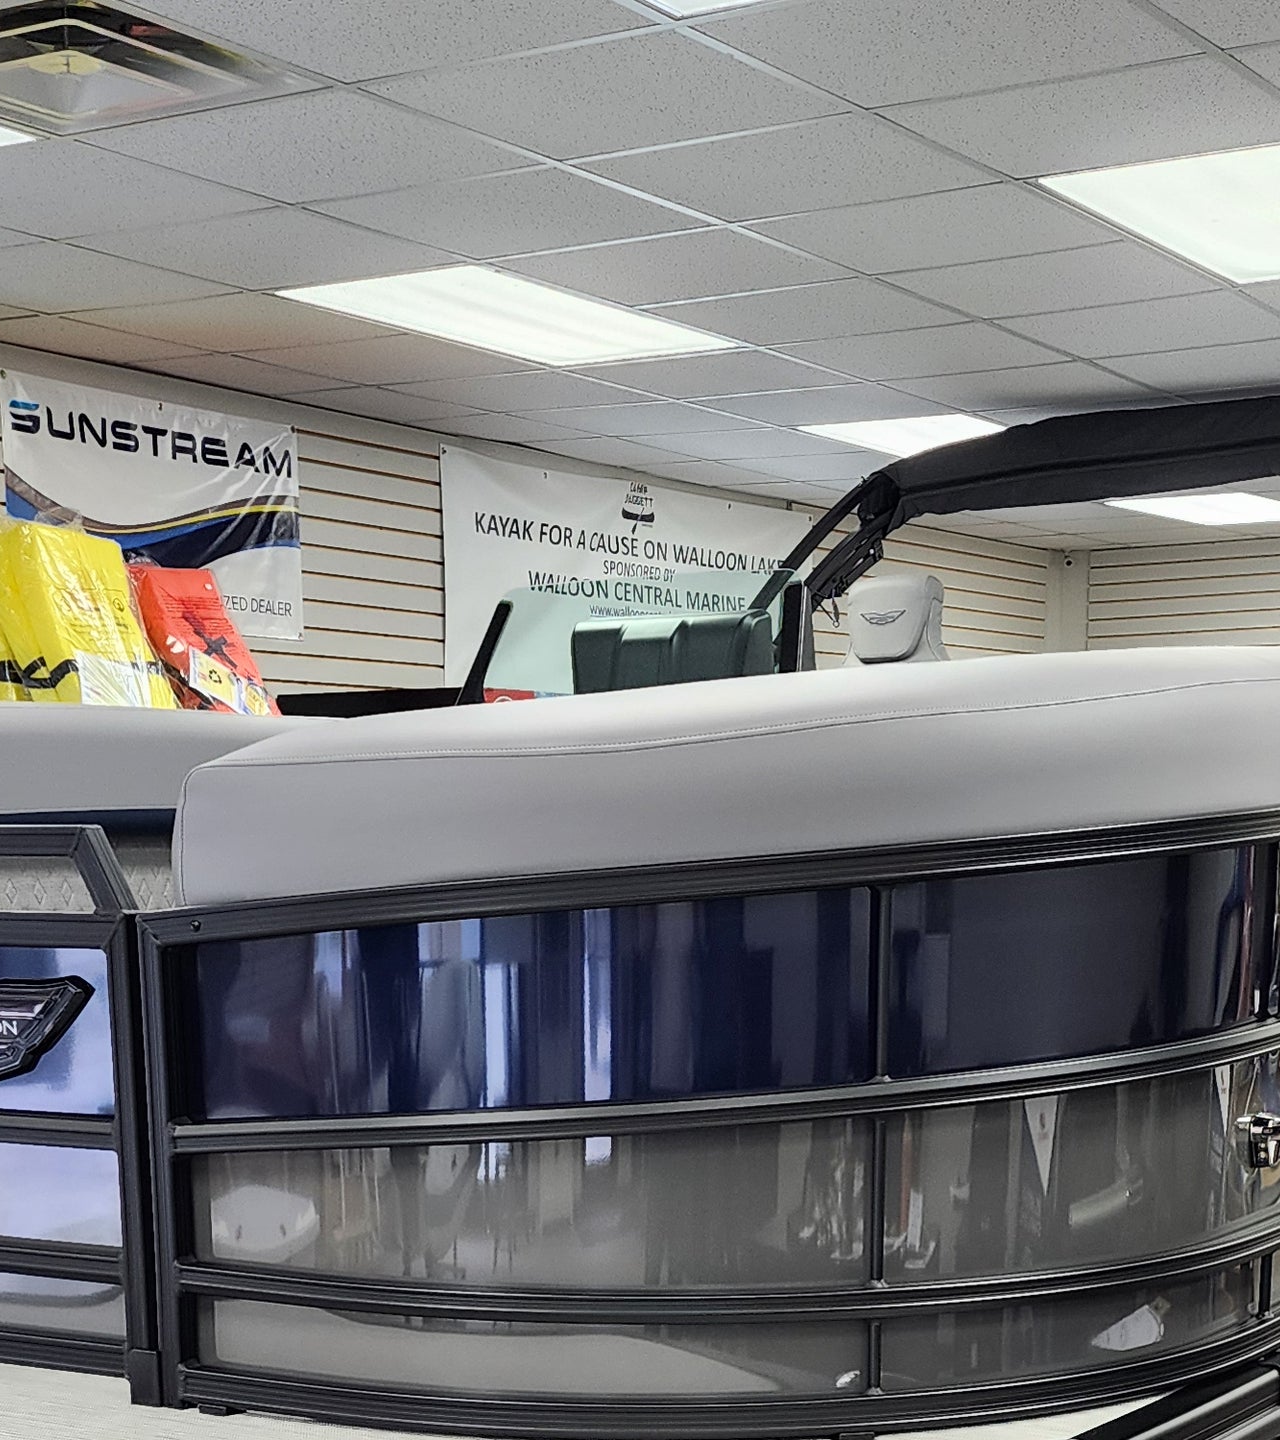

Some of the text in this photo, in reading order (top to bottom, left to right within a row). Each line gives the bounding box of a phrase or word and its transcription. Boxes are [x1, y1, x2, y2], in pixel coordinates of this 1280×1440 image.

[9, 399, 292, 478] SUNSTREAM
[474, 511, 534, 542] KAYAK
[539, 522, 573, 548] FOR
[576, 529, 586, 550] A
[589, 531, 639, 557] CAUSE
[643, 539, 668, 562] ON
[673, 543, 748, 571] WALLOON
[528, 570, 745, 611] WALLOON CENTRAL MARINE
[603, 559, 676, 583] SPONSORED BY
[250, 597, 293, 617] DEALER
